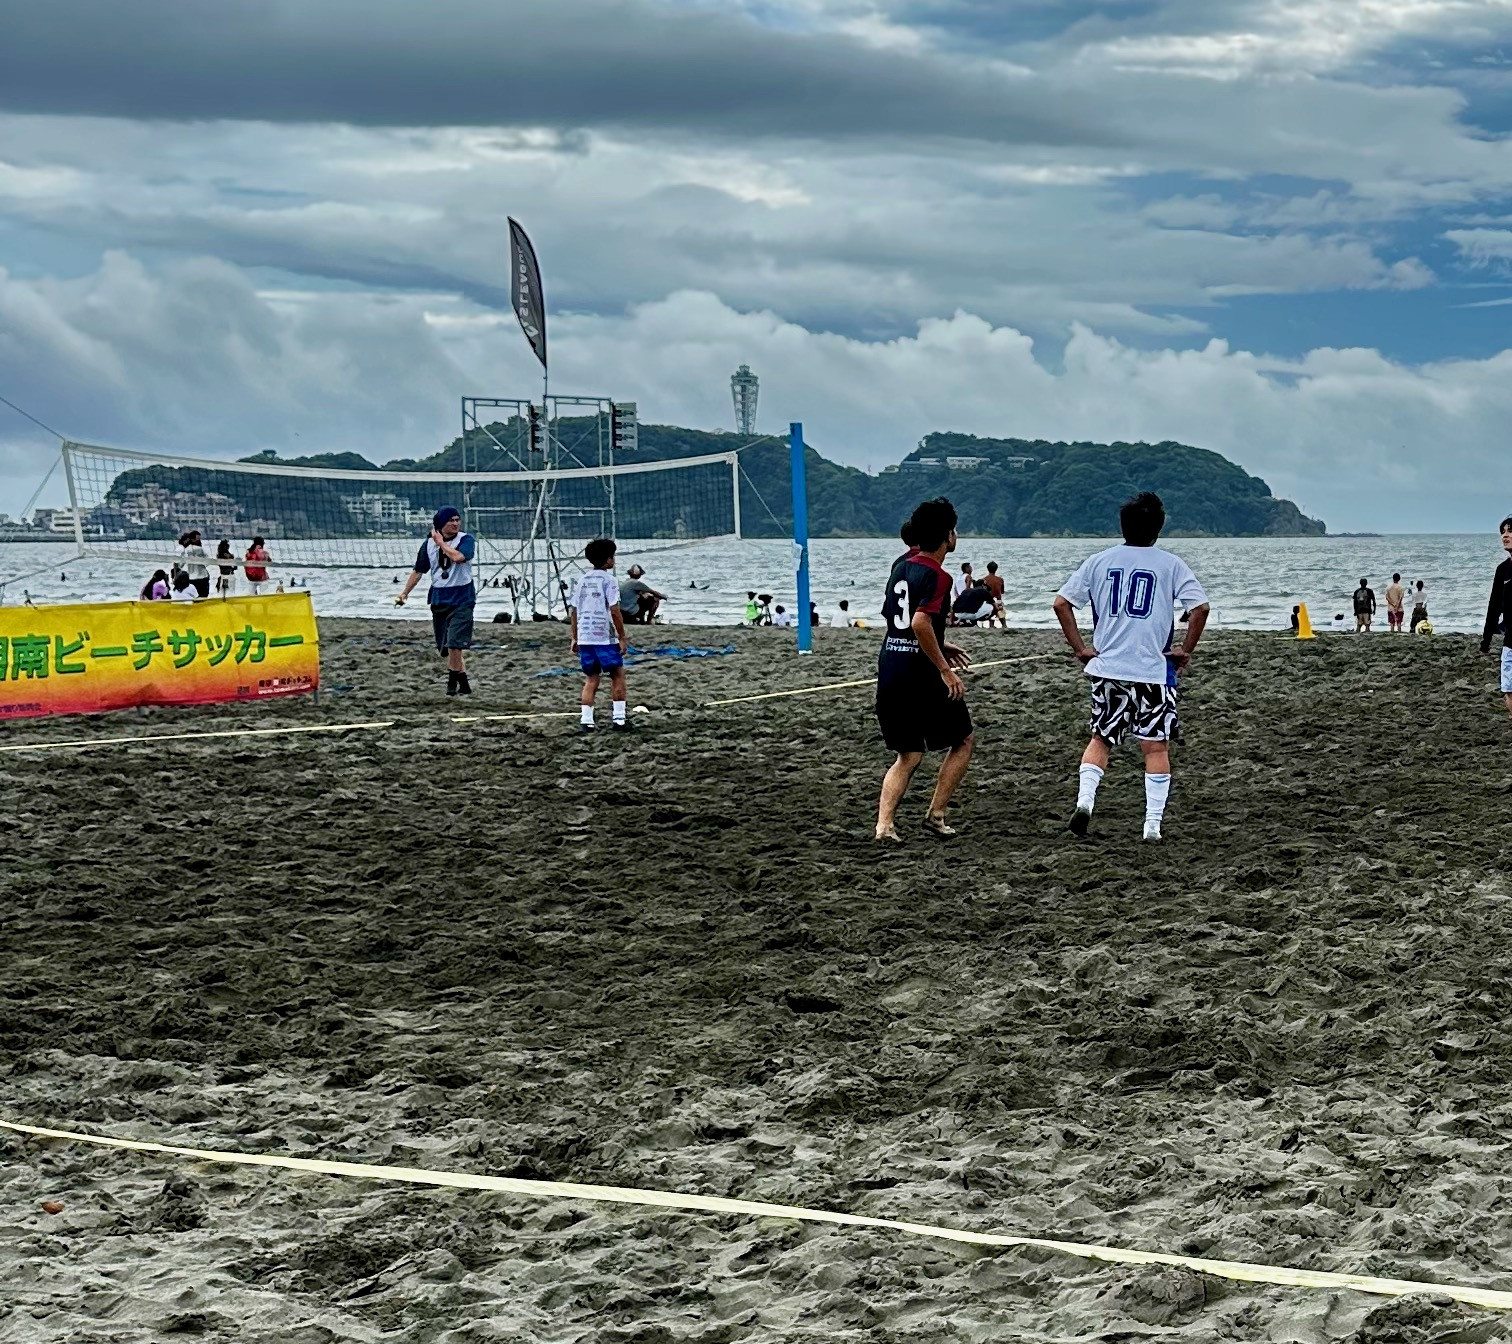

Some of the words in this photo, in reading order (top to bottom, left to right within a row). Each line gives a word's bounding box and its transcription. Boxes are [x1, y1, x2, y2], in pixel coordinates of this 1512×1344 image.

[893, 579, 911, 630] 3
[1106, 567, 1157, 620] 10
[0, 624, 304, 681] 南ビーチサッカー
